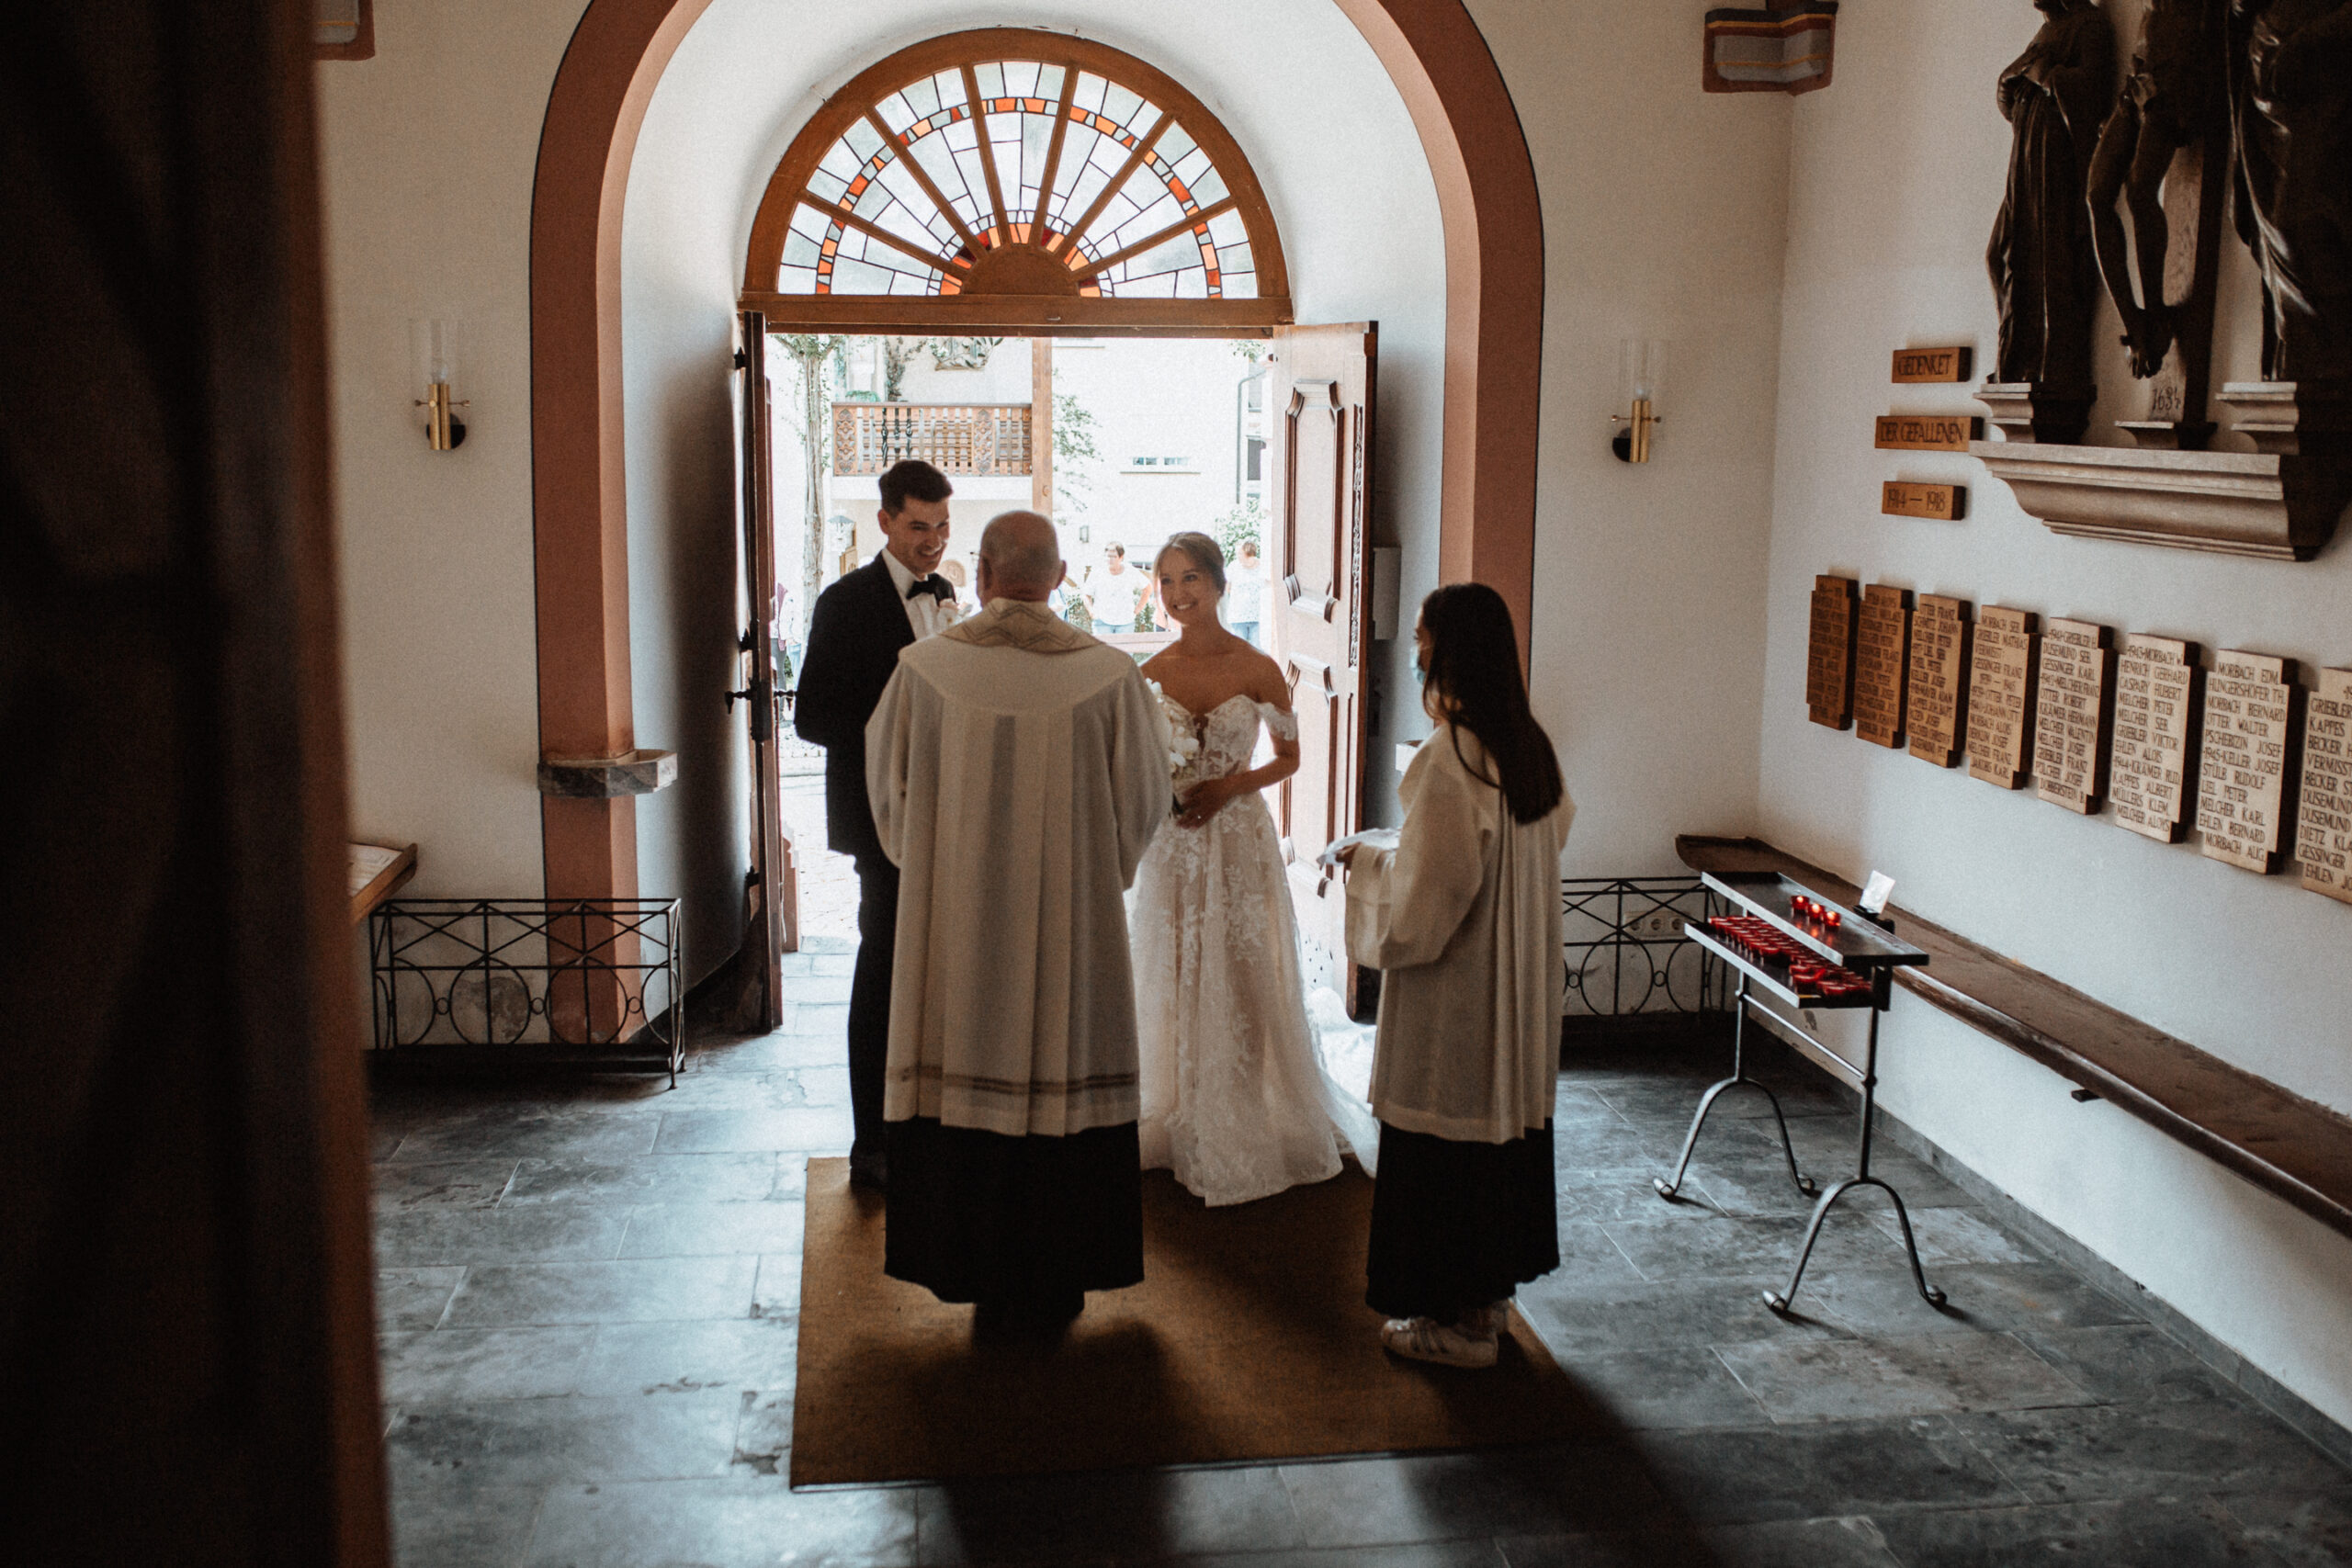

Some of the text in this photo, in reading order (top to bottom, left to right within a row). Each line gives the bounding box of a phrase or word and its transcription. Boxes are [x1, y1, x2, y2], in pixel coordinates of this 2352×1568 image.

[1896, 354, 1952, 376] GEDENKET
[1880, 422, 1964, 444] DER GEFALLENEN
[1886, 488, 1906, 505] 1914
[1926, 491, 1946, 512] 1918
[2154, 666, 2188, 684] GERHARD
[2218, 661, 2255, 681] MORBACH
[2119, 675, 2181, 700] CASPARY HUBERT
[2118, 692, 2175, 716] MELCHER PETER
[2206, 694, 2286, 723] MORBACH BERNARD
[2117, 707, 2148, 726] MELCHER
[2206, 712, 2269, 738] OTTER WALTER
[2308, 716, 2346, 737] KAPPES
[2114, 739, 2135, 756] EHLEN
[2115, 723, 2179, 750] GRIEBLER VIKTOR
[2307, 734, 2342, 754] BECKER
[2256, 740, 2282, 759] JOSEF
[2066, 756, 2087, 773] FRANZ
[2255, 758, 2279, 776] JOSEF
[2112, 771, 2173, 799] KAPPES ALBERT
[2233, 771, 2266, 791] RUDOLF
[2304, 771, 2338, 793] BECKER
[2223, 785, 2247, 804] PETER
[2302, 789, 2352, 815] DUSEMUND
[2116, 805, 2145, 824] MELCHER
[2199, 796, 2267, 827] MELCHER KARL
[2301, 807, 2351, 832] DUSEMUND
[2199, 813, 2266, 844] EHLEN BERNARD
[2300, 825, 2325, 845] DIETZ
[2205, 832, 2242, 854] MORBACH
[2298, 843, 2346, 870] GESSINGER
[2305, 863, 2334, 883] EHLEN
